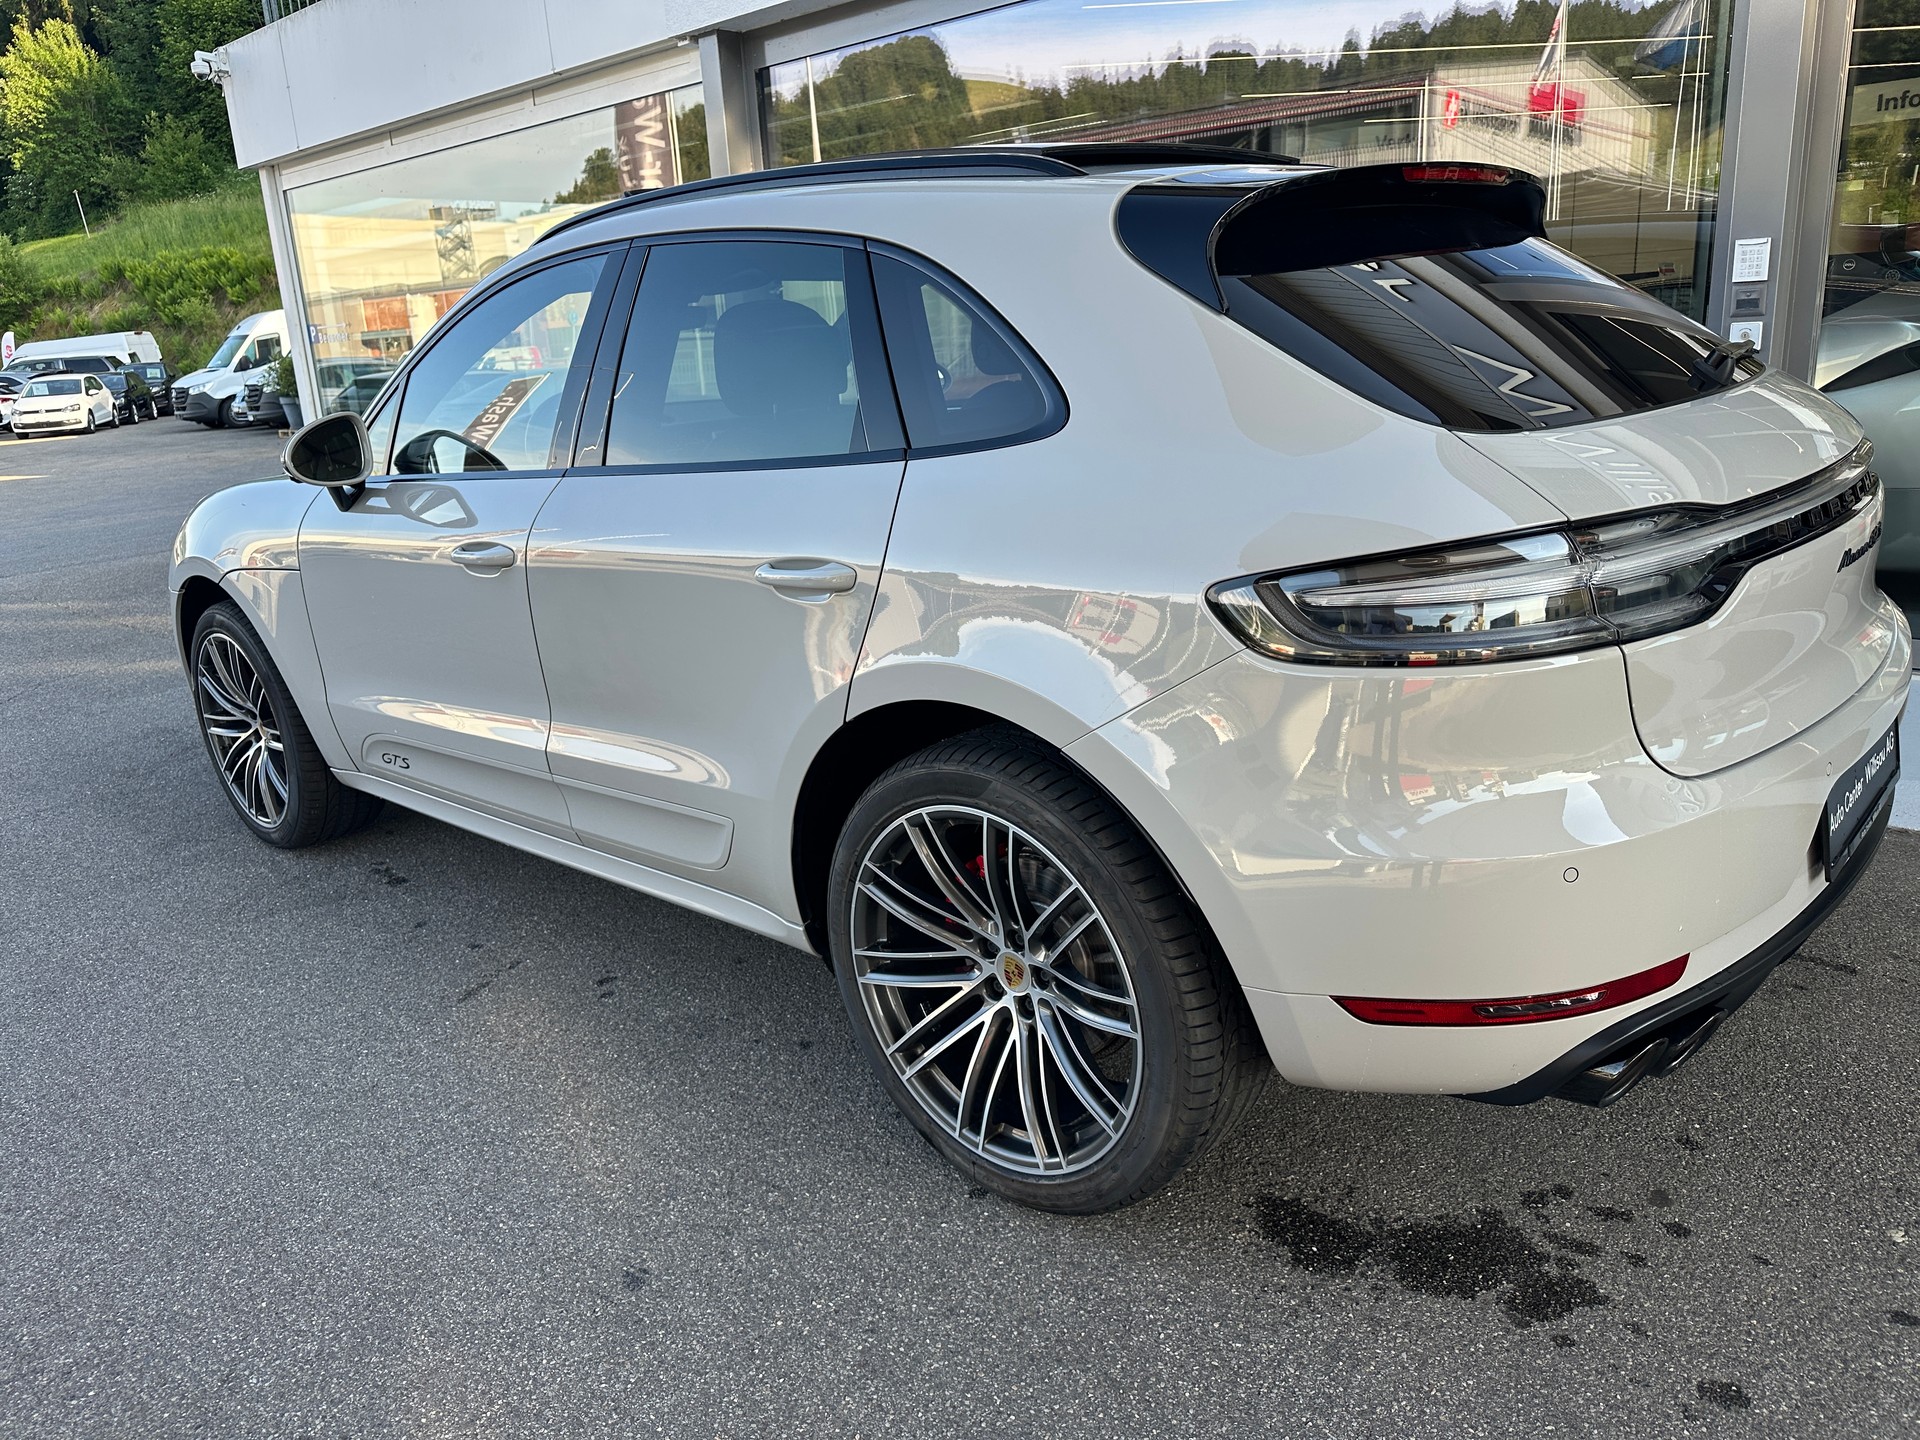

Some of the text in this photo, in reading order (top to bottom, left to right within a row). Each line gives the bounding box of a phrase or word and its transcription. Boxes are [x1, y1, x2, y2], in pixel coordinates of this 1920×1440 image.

[1876, 90, 1920, 112] Info
[1785, 470, 1875, 540] PORSCH
[381, 752, 410, 769] GTS
[1829, 803, 1845, 837] Auto
[1844, 777, 1864, 813] Center
[1885, 731, 1895, 754] AG
